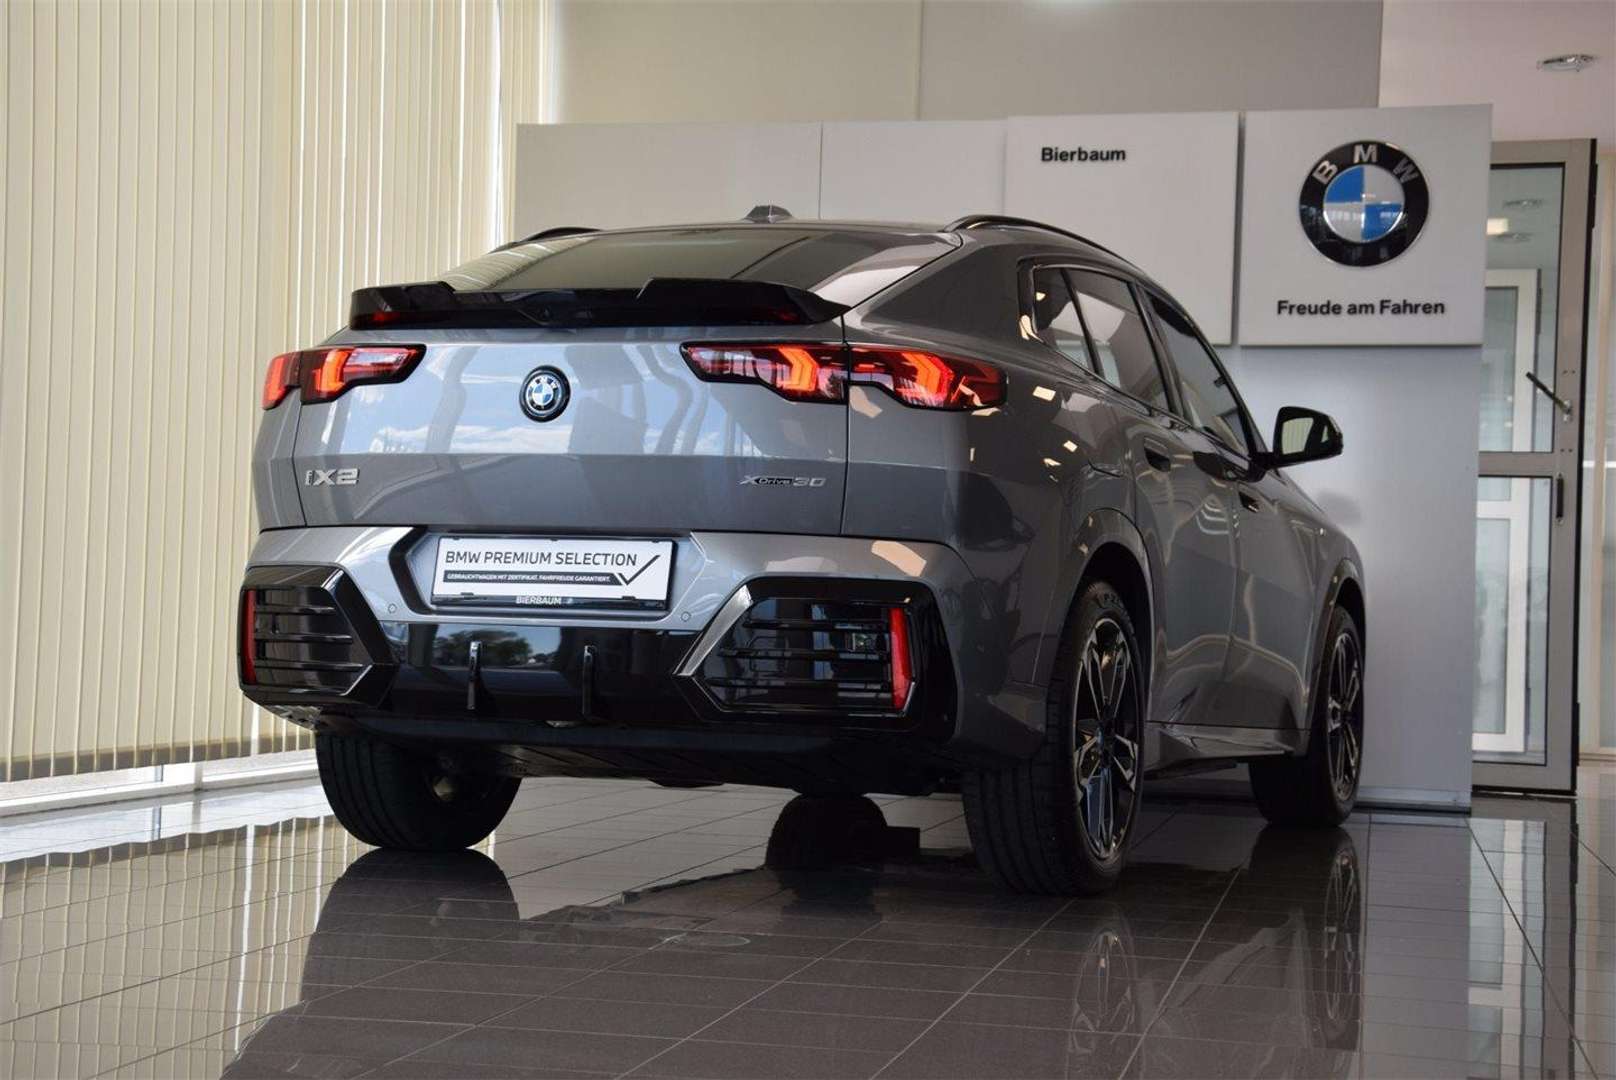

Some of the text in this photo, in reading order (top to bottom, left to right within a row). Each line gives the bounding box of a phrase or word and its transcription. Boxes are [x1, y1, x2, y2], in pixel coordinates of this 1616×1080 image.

[1040, 146, 1127, 162] Bierbaum
[1311, 143, 1421, 185] BMW
[1277, 299, 1446, 317] Freude am Fahren
[304, 468, 360, 487] iX2
[444, 550, 638, 567] BMW PREMIUM SELECTION
[515, 595, 563, 605] BIERBAUM
